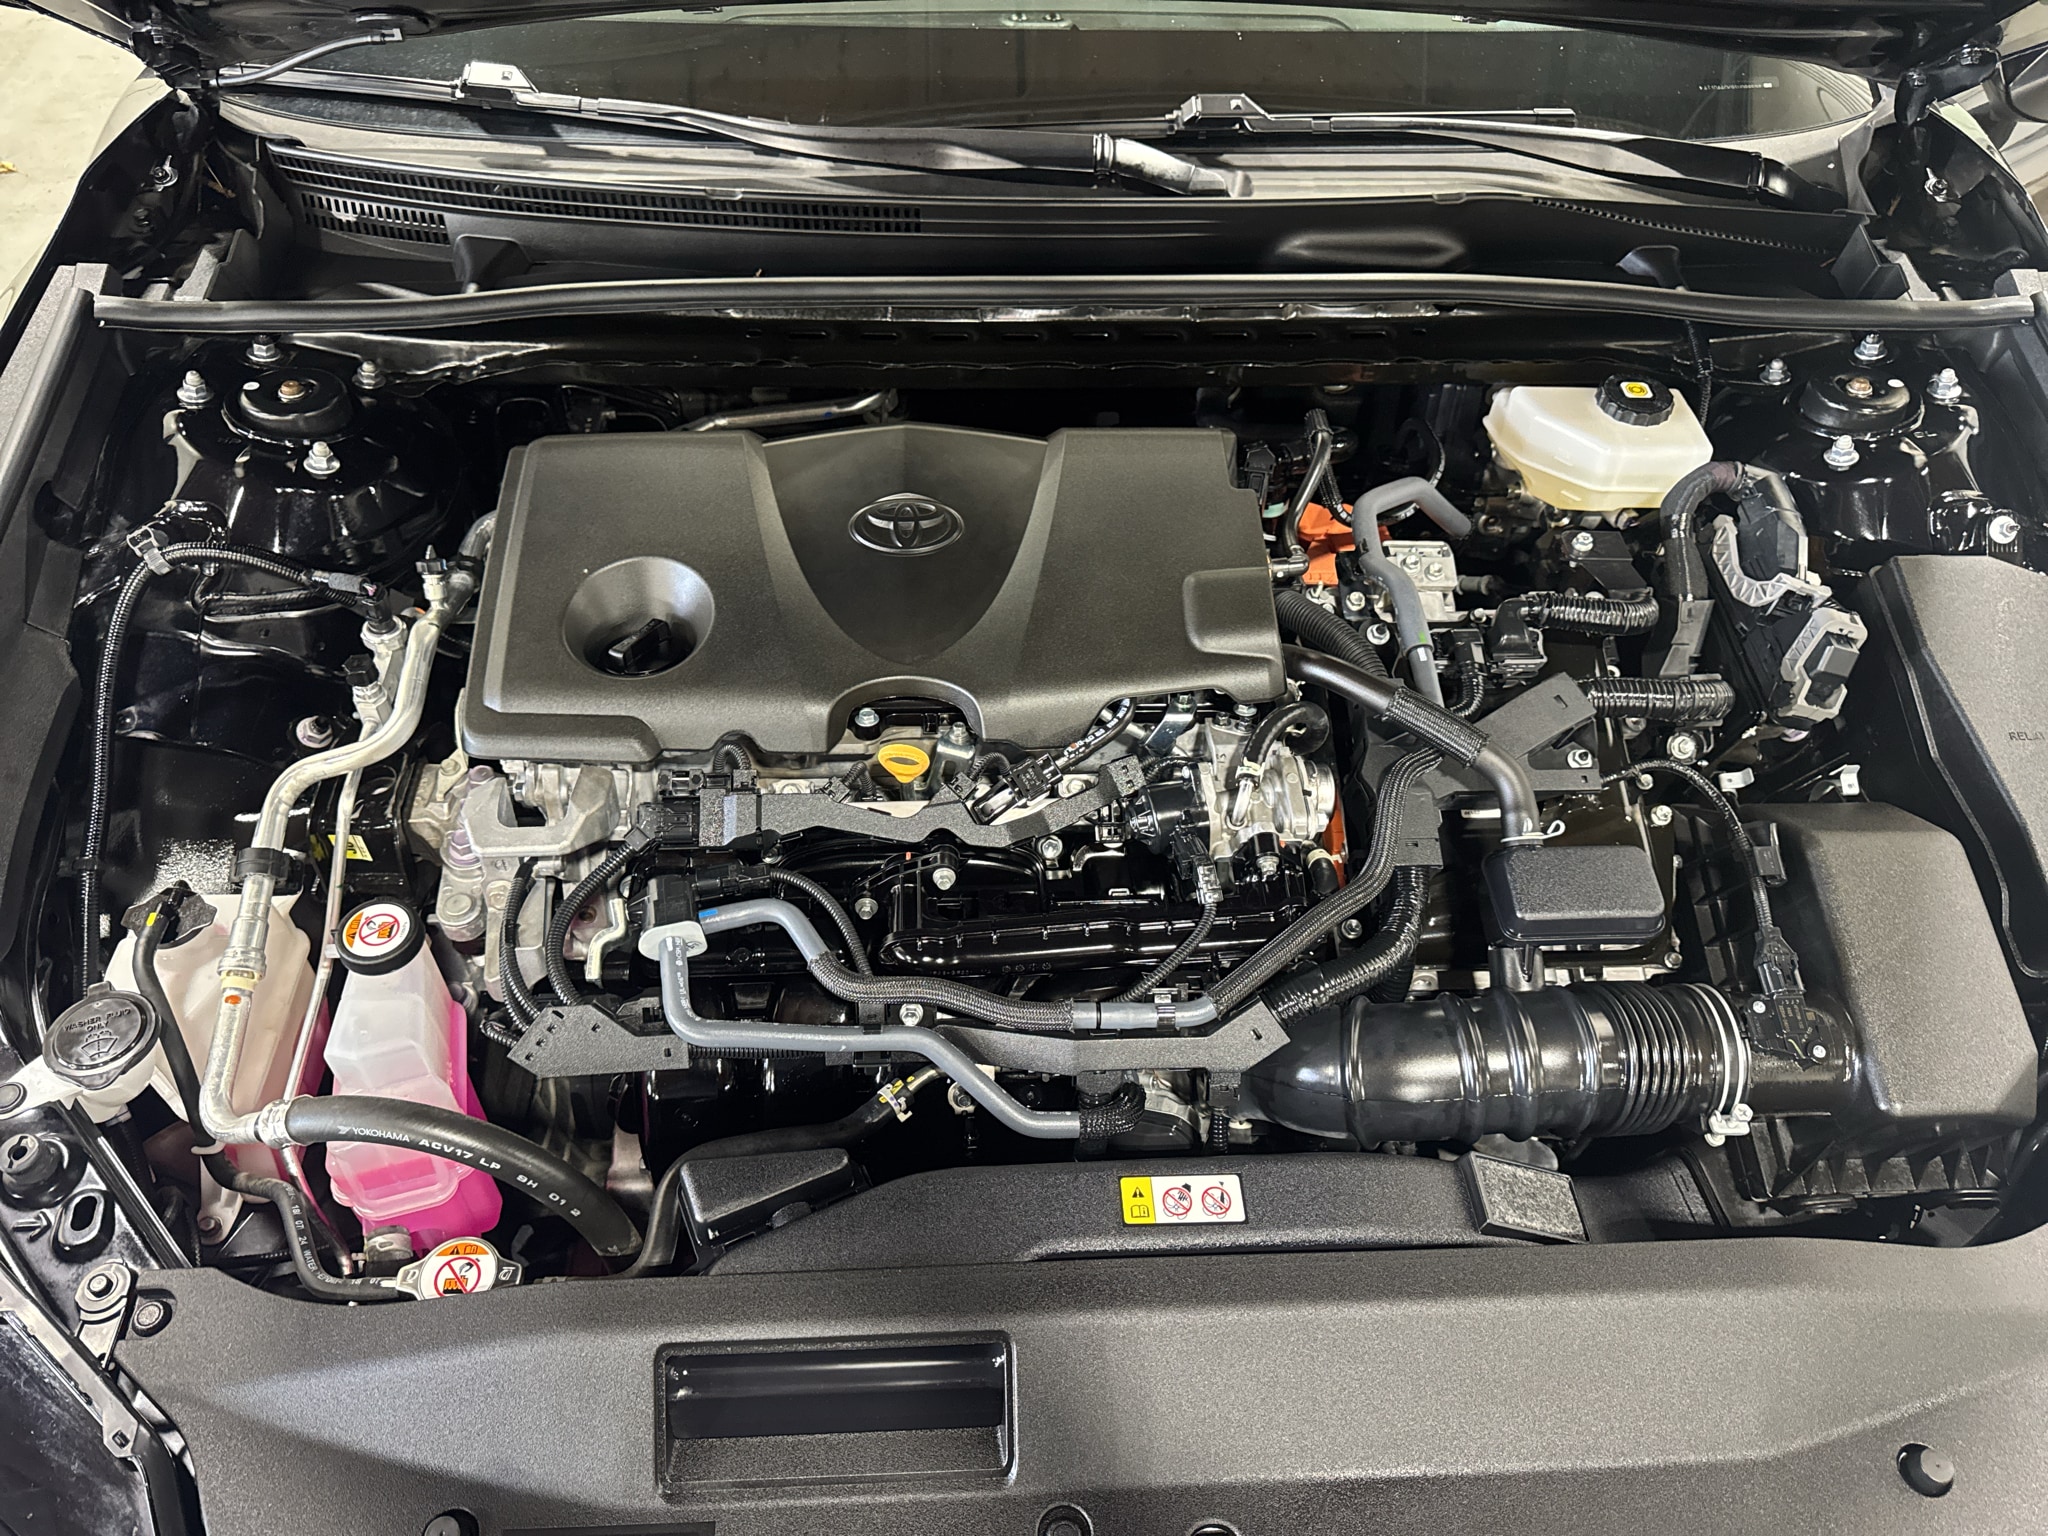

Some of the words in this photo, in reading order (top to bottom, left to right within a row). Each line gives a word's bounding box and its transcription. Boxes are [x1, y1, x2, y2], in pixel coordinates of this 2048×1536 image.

[65, 1016, 102, 1032] WASHER
[106, 1008, 131, 1020] FLUID
[86, 1020, 110, 1032] ONLY
[352, 1127, 410, 1143] YOKOHAMA
[418, 1139, 474, 1159] ACV17
[479, 1157, 501, 1170] LP
[516, 1174, 539, 1188] 9H
[303, 1249, 318, 1272] WATER
